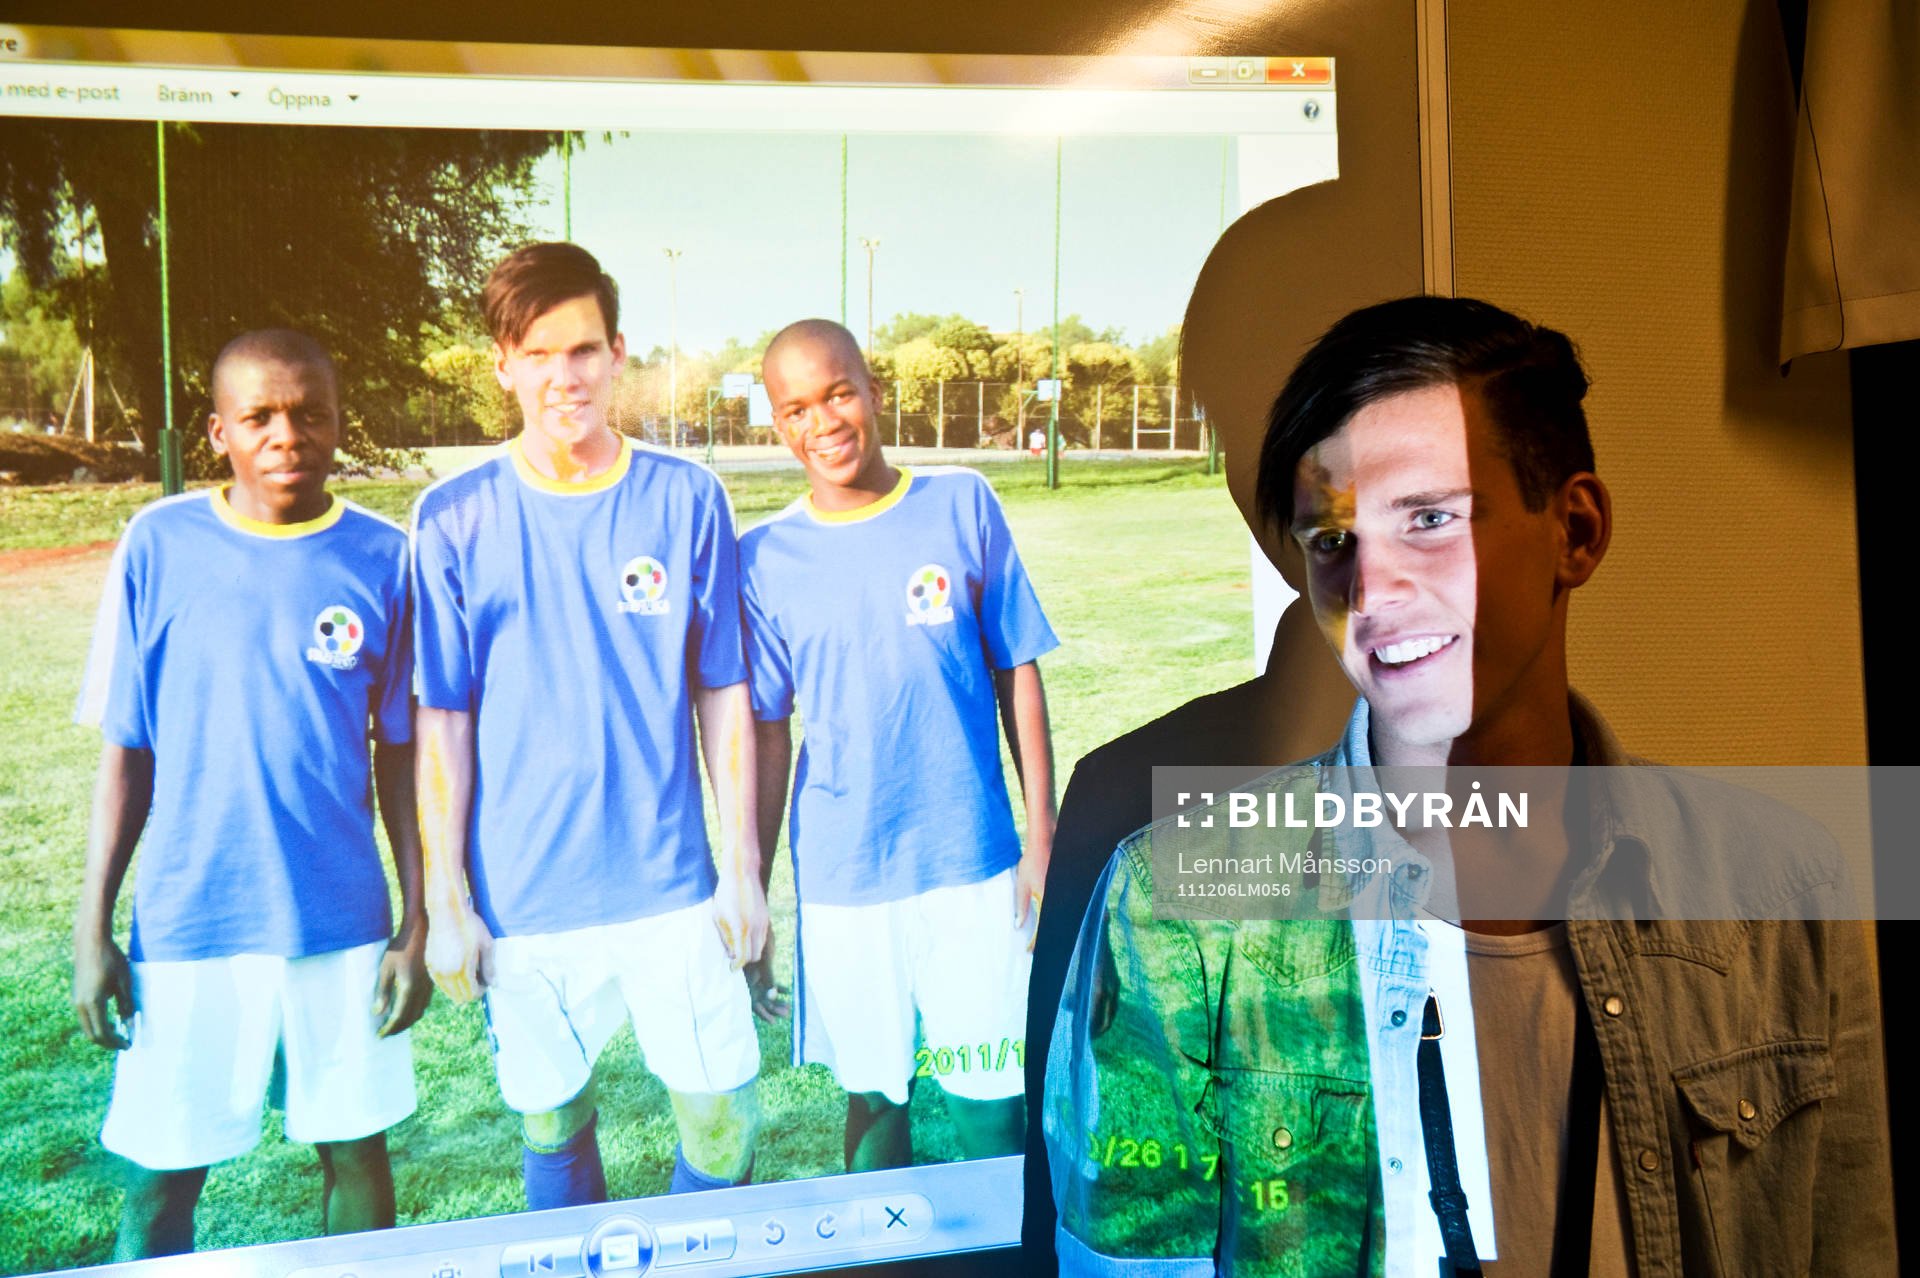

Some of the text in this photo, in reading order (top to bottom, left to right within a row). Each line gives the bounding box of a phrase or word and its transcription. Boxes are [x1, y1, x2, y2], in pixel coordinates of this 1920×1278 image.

[7, 80, 332, 109] med e-post Bränn Öppna
[914, 1037, 1024, 1078] 2011/1
